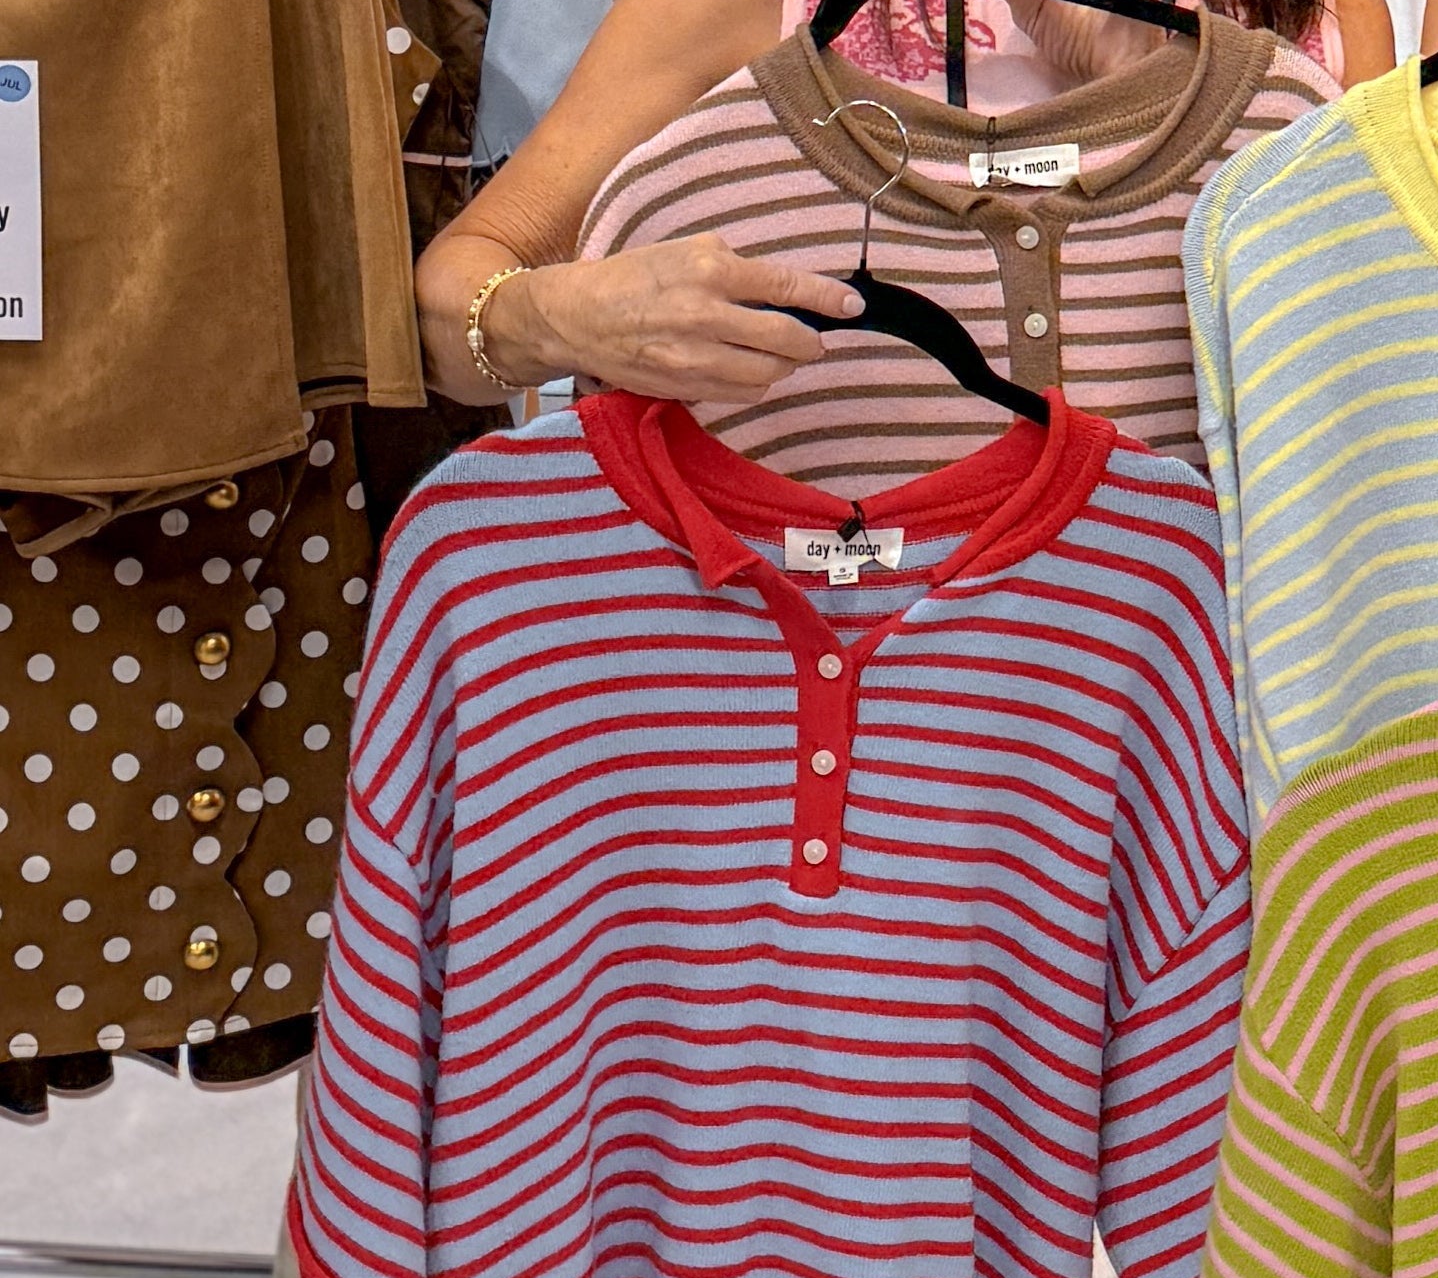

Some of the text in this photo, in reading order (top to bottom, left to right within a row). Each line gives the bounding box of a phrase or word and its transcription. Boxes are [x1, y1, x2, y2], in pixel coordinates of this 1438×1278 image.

[1024, 160, 1058, 174] moon
[807, 541, 830, 559] day
[845, 544, 881, 556] moon
